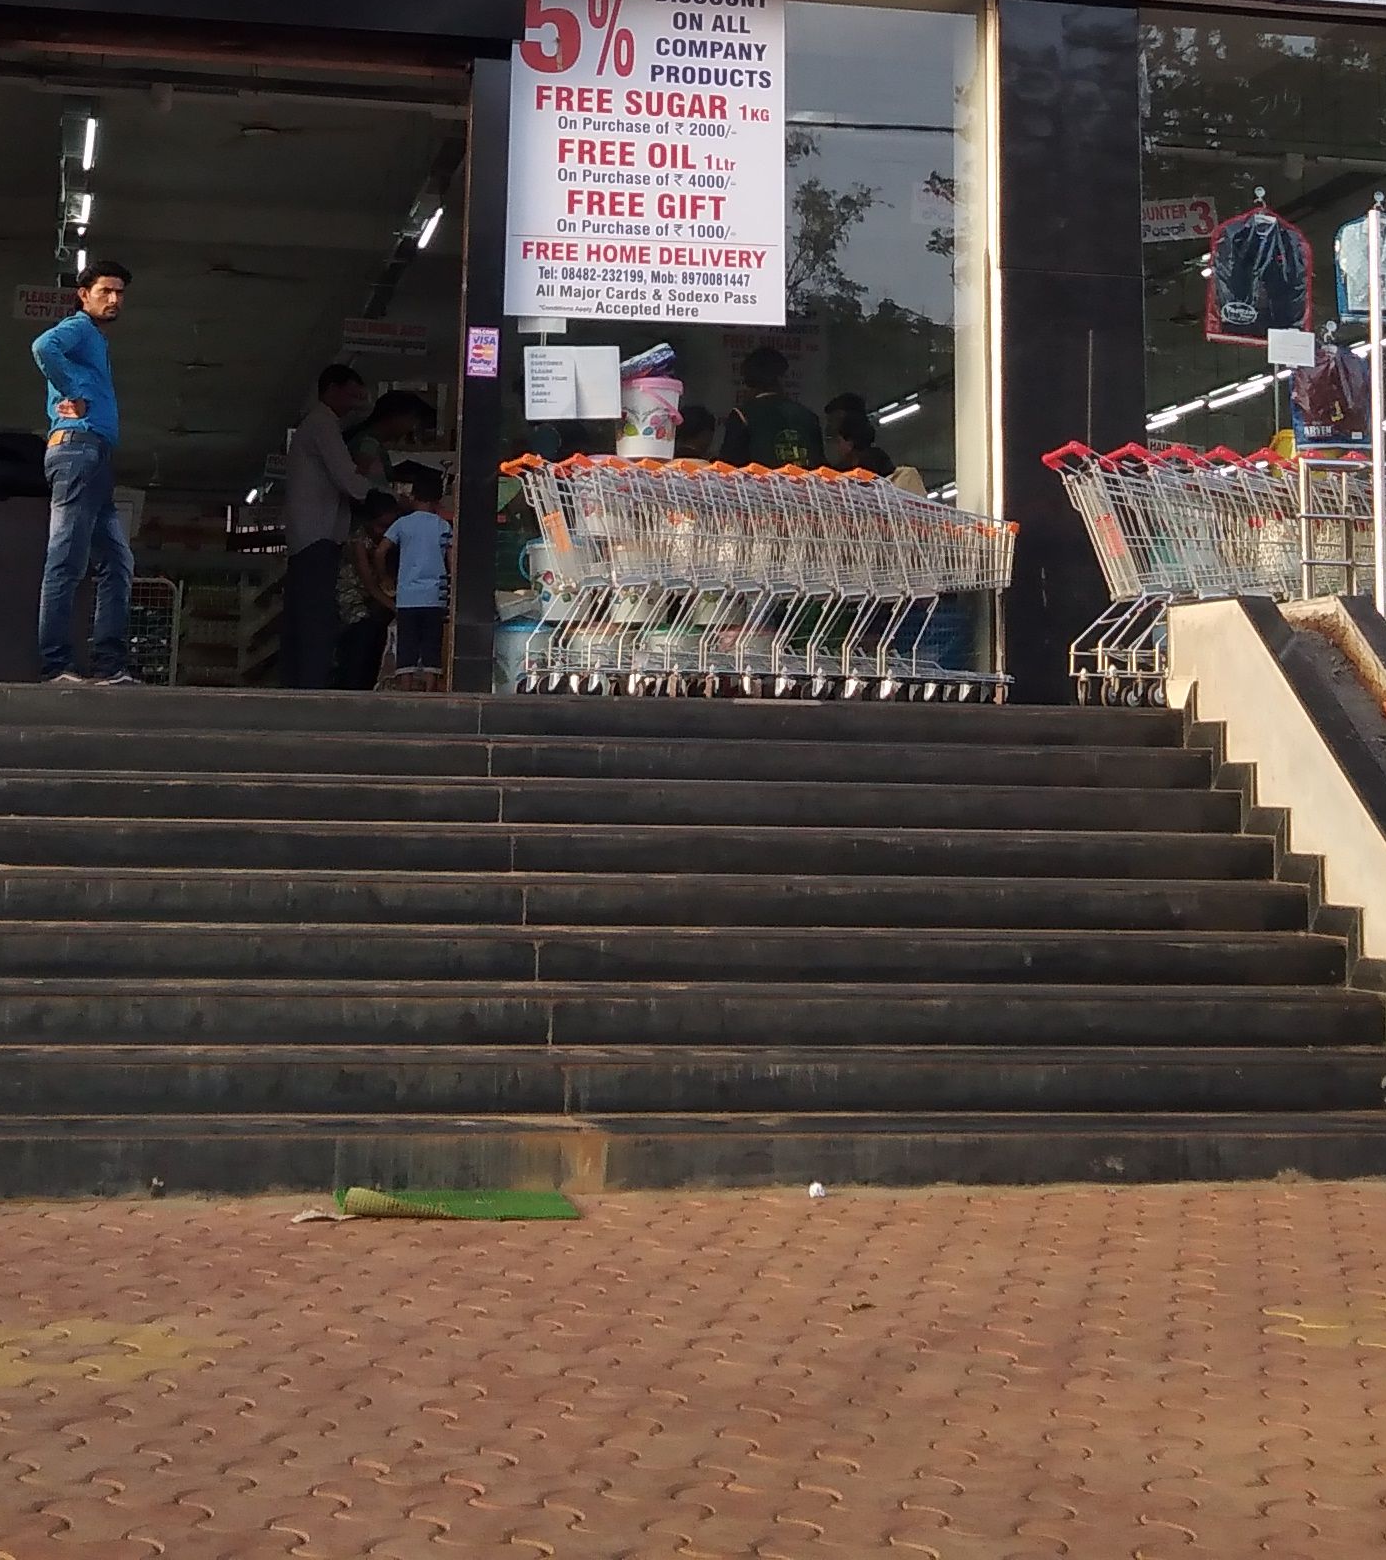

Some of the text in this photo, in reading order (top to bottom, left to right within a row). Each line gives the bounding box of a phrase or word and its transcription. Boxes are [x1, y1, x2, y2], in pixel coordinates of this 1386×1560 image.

[672, 11, 751, 34] ON ALL
[655, 37, 767, 62] COMPANY
[650, 64, 772, 88] PRODUCTS
[535, 85, 613, 114] FREE
[625, 90, 727, 120] SUGAR
[558, 116, 577, 130] On
[582, 117, 651, 135] Purchase
[655, 120, 670, 135] of
[558, 138, 635, 167] FREE
[648, 142, 696, 170] OIL
[557, 168, 577, 183] On
[582, 169, 651, 186] Purchase
[655, 172, 669, 186] of
[567, 189, 727, 221] FREE GIFT
[557, 219, 576, 233] On
[581, 220, 651, 237] Purchase
[655, 223, 669, 237] of
[1143, 200, 1214, 235] UNTER 3
[522, 241, 767, 269] FREE HOME DELIVERY
[538, 266, 751, 287] Tel: 08482-232199, Mob: 8970081447
[536, 284, 758, 305] All Major Cards & Sodexo Pass
[594, 301, 699, 317] Accepted Here
[473, 335, 497, 346] VISA
